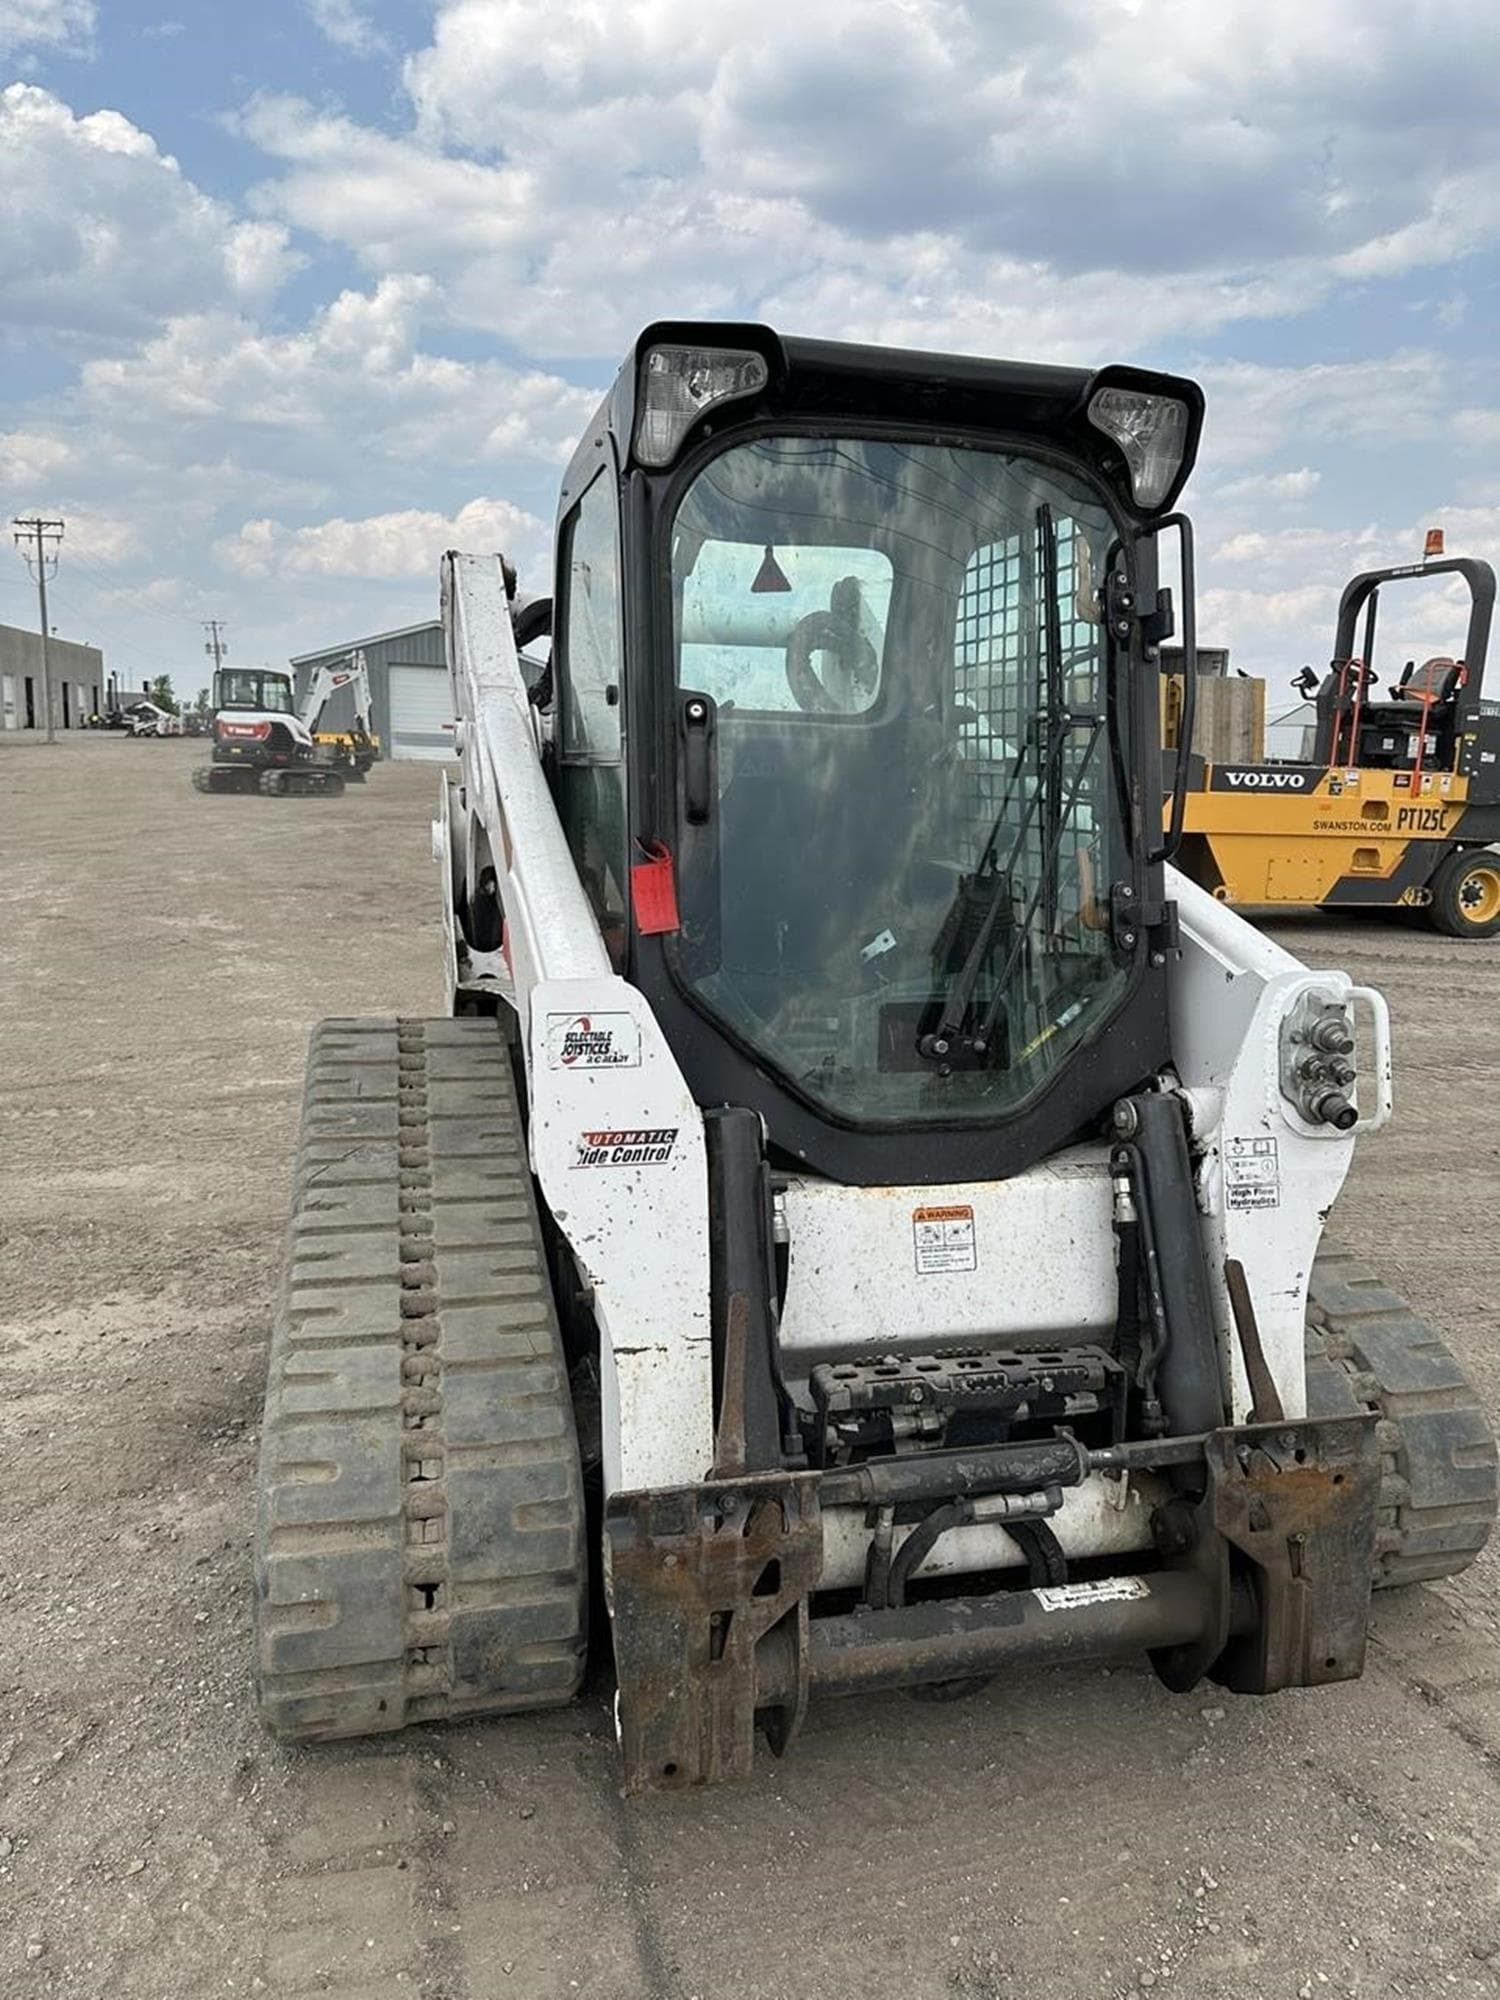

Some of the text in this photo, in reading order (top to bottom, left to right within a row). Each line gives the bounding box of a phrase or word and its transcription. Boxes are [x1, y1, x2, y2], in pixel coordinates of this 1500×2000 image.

[1225, 772, 1305, 788] VOLVO
[1397, 807, 1449, 831] PT125C
[1313, 820, 1392, 832] SWANSTON.COM
[564, 1031, 613, 1043] SELECTABLE
[560, 1042, 611, 1056] JOYSTICKS
[584, 1131, 673, 1145] AUTOMATIC
[611, 1144, 673, 1163] Control
[1231, 1189, 1252, 1198] High
[1230, 1197, 1276, 1207] Hydraulics
[927, 1209, 969, 1219] WARNING
